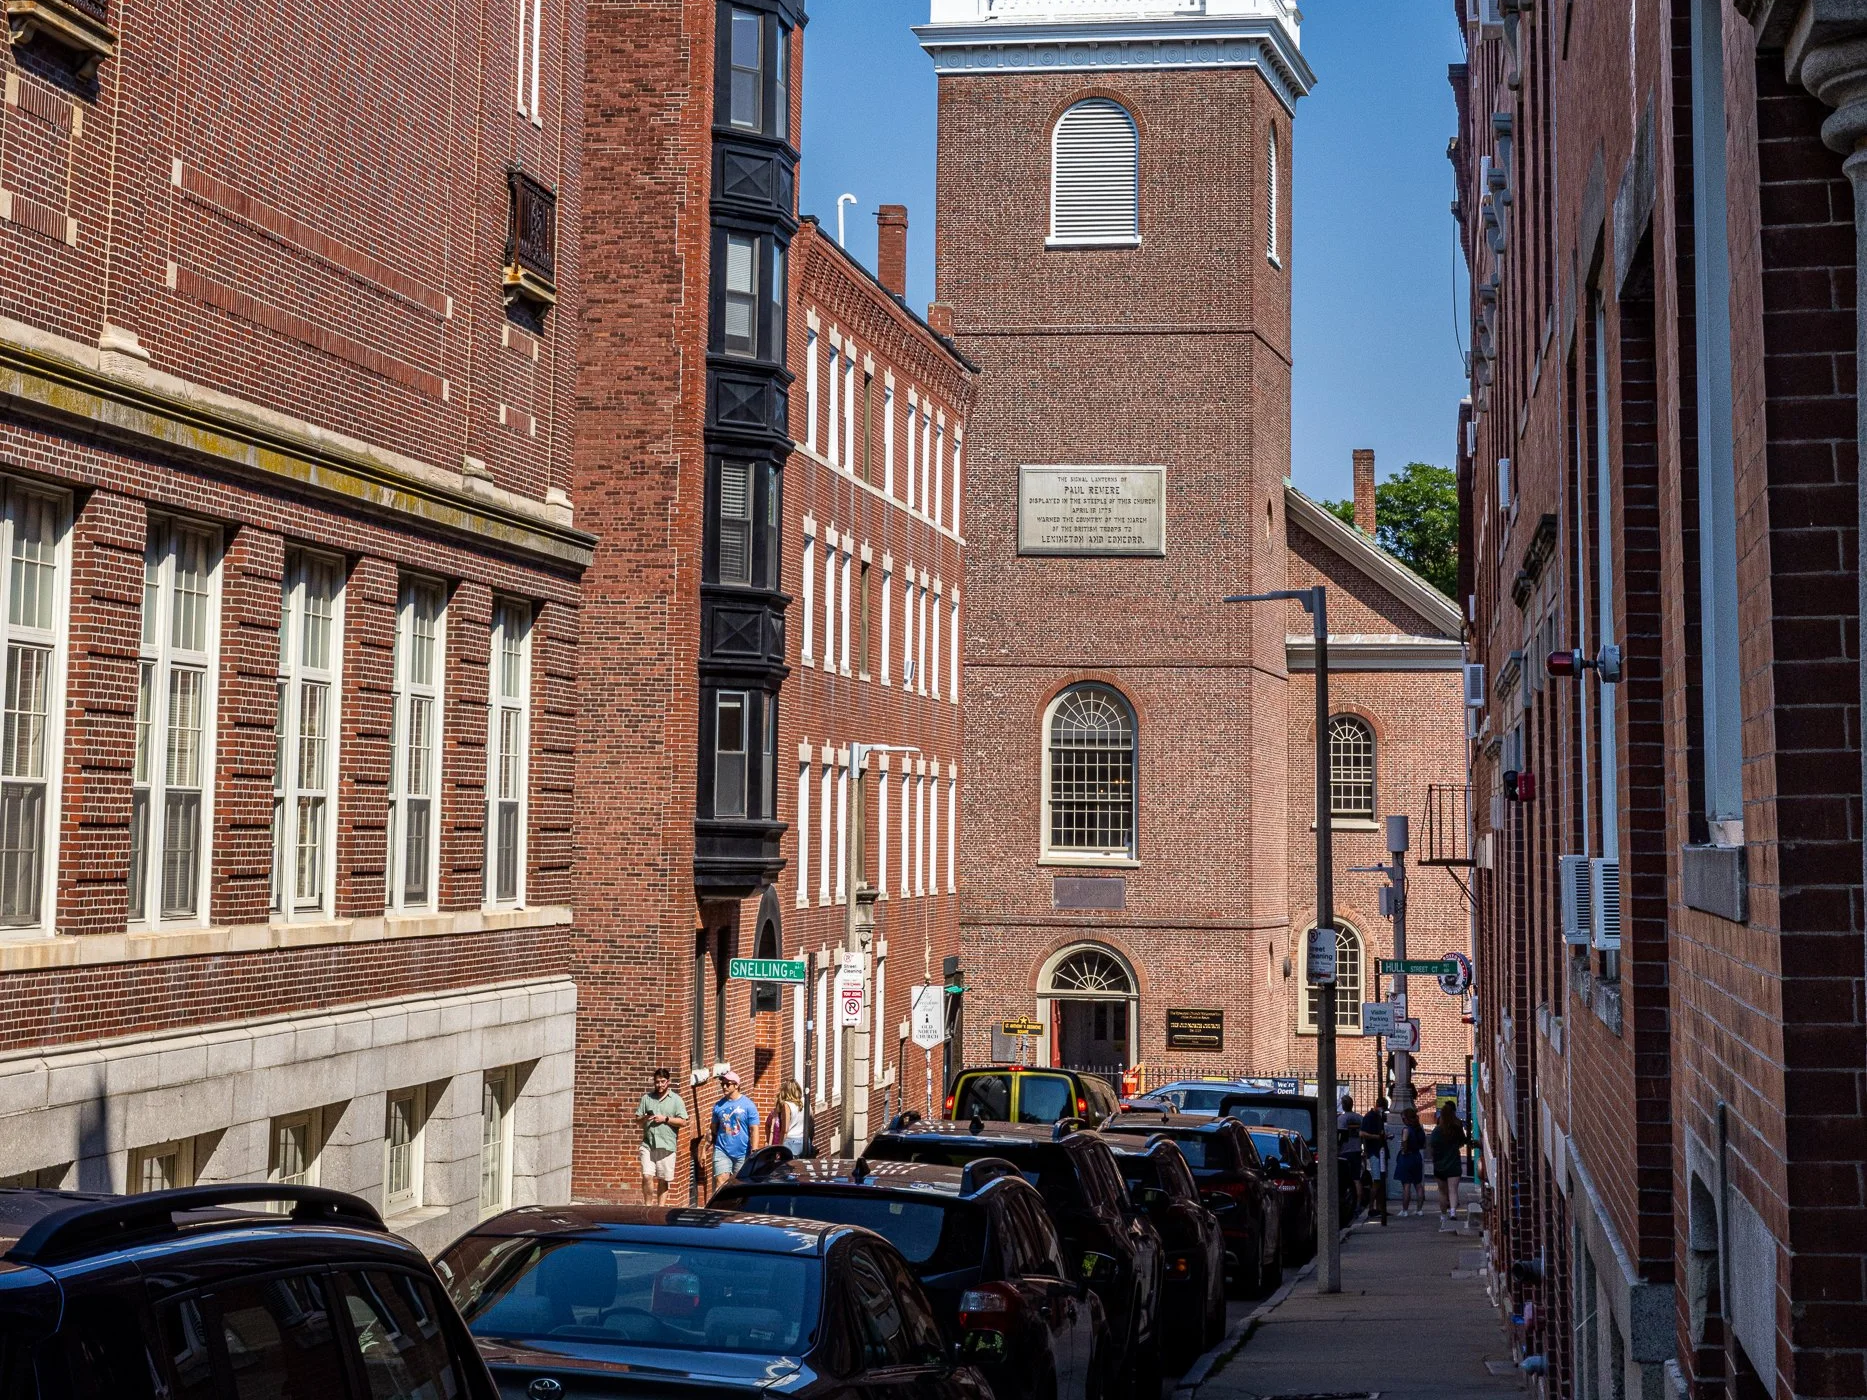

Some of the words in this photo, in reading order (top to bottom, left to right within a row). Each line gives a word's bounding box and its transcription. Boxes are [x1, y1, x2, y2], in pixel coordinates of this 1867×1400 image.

[1064, 486, 1084, 494] PAUL
[732, 962, 787, 977] SNELLING
[1386, 962, 1405, 972] HULL
